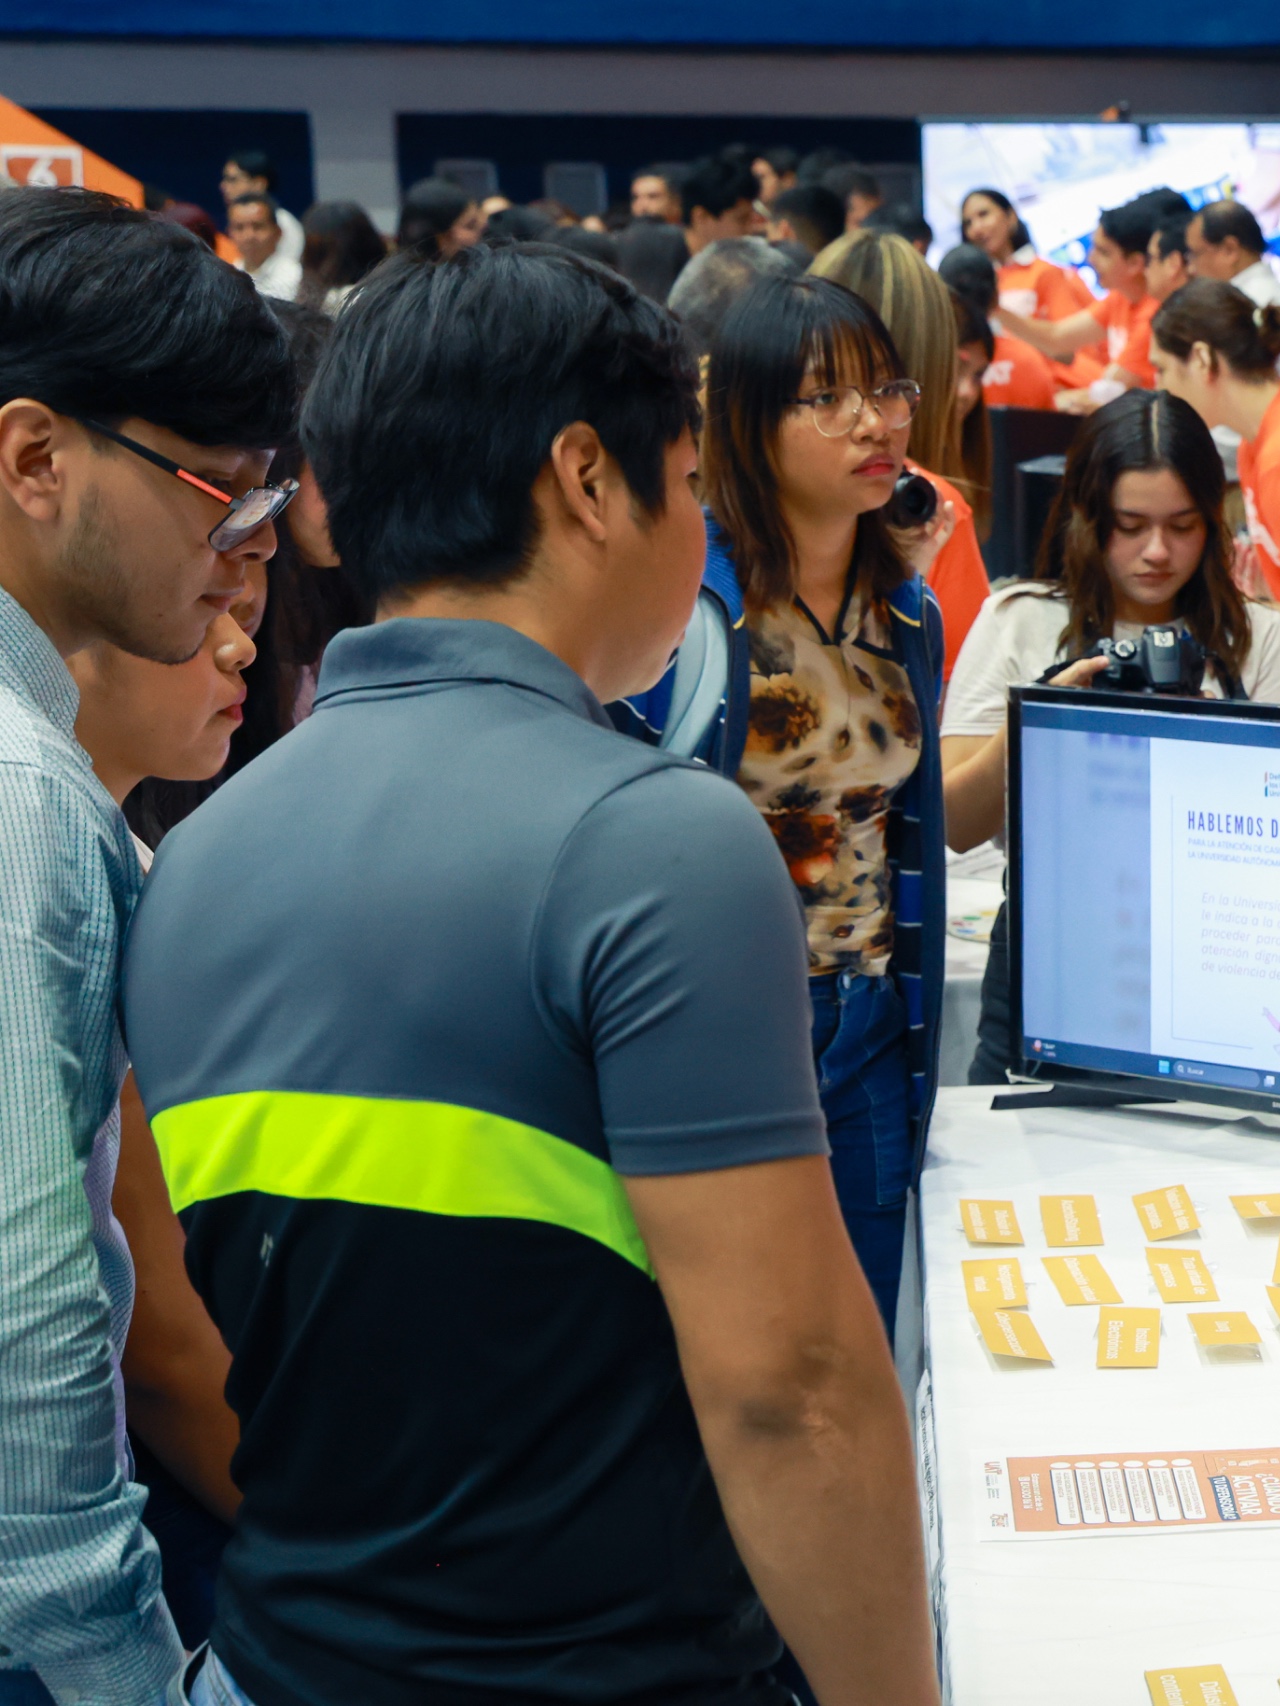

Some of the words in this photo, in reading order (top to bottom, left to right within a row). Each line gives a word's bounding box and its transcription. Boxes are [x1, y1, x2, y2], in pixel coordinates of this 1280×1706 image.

[1188, 810, 1263, 837] HABLEMOS
[1207, 840, 1216, 848] LA
[1253, 845, 1262, 853] DE
[1188, 851, 1196, 859] LA
[1198, 852, 1241, 864] UNIVERSIDAD
[1202, 892, 1215, 904] En
[1219, 893, 1229, 906] la
[1202, 909, 1211, 921] le
[1214, 910, 1248, 925] indica
[1251, 917, 1259, 926] a
[1263, 916, 1273, 928] la
[1201, 927, 1250, 940] proceder
[1201, 944, 1249, 959] atención
[1201, 960, 1215, 972] de
[1218, 963, 1266, 978] violencia
[1154, 1263, 1177, 1287] personas
[1106, 1320, 1125, 1359] Electrónicos
[1135, 1328, 1152, 1353] Insultos
[1231, 1475, 1263, 1515] ACTIVAR
